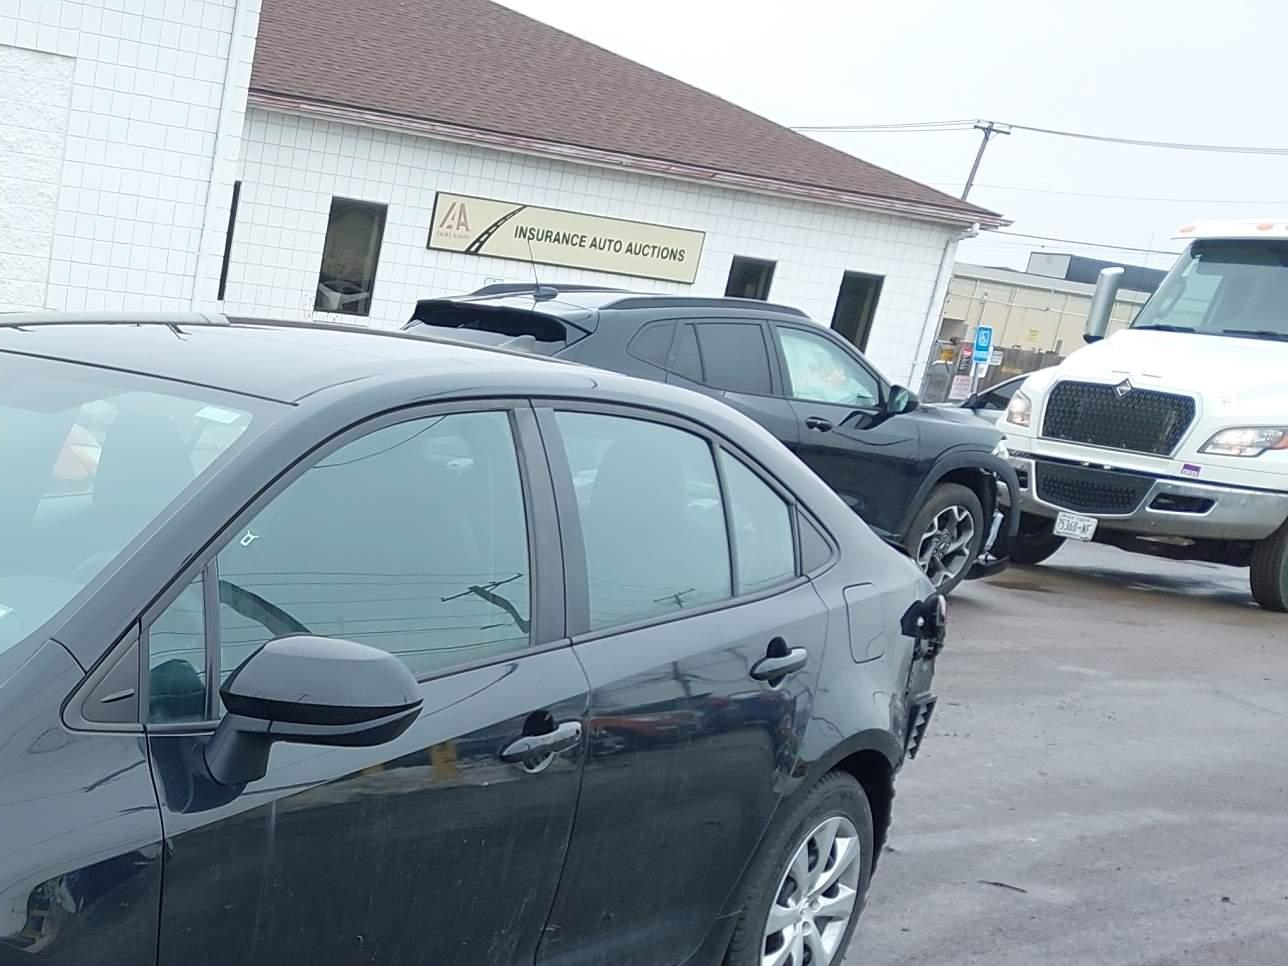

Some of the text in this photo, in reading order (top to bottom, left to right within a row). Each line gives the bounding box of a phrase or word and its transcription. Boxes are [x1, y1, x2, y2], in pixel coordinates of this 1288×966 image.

[514, 225, 686, 262] INSURANCE AUTO AUCTIONS
